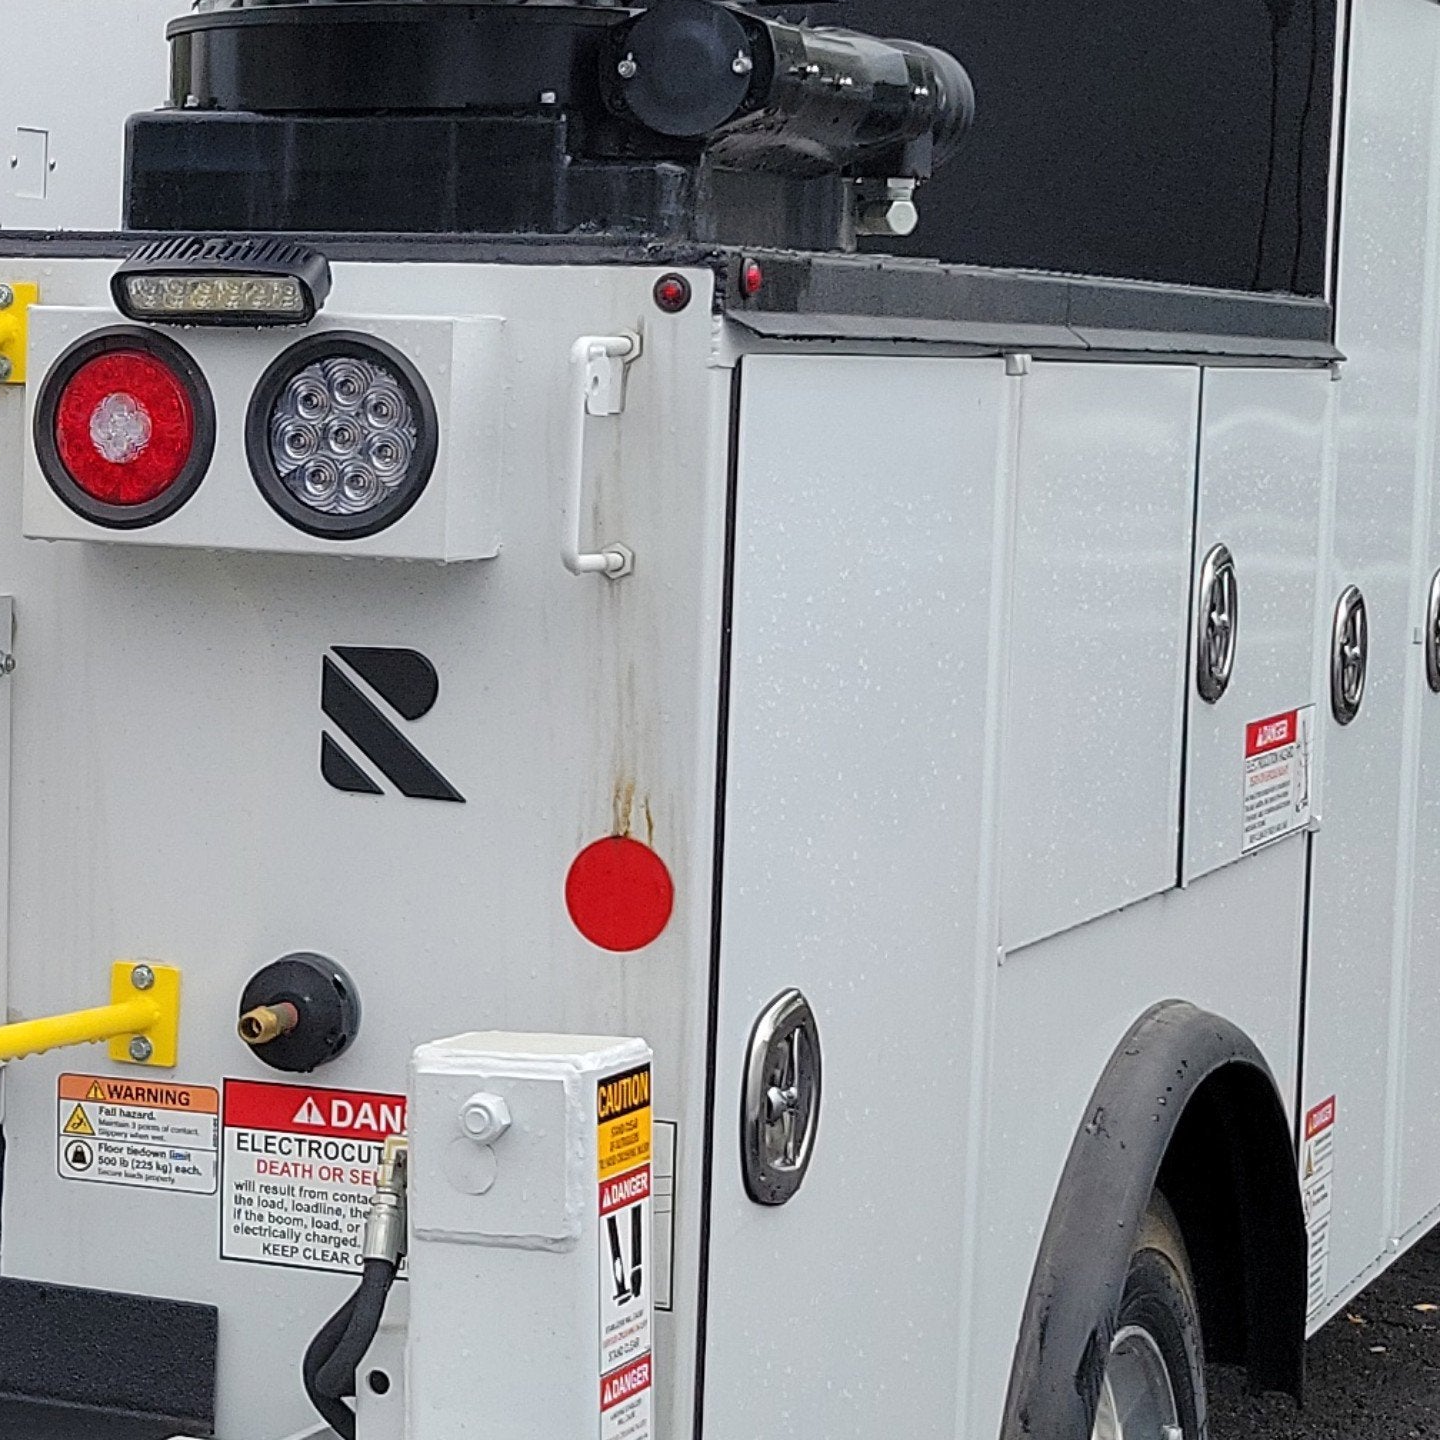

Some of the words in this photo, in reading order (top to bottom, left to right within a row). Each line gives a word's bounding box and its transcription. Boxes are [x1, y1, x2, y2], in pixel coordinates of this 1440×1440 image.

[107, 1084, 190, 1106] WARNING
[598, 1071, 649, 1117] CAUTION
[98, 1106, 116, 1116] Fall
[119, 1109, 156, 1120] hazard.
[331, 1099, 407, 1133] DAN
[98, 1143, 124, 1154] Floor
[127, 1145, 167, 1158] tiedown
[98, 1157, 117, 1167] 500
[120, 1158, 129, 1168] lb
[131, 1160, 154, 1171] (225
[155, 1162, 172, 1174] kg)
[175, 1165, 202, 1176] each.
[256, 1159, 313, 1179] DEATH
[318, 1165, 344, 1183] OR
[234, 1180, 255, 1193] will
[259, 1182, 295, 1197] result
[299, 1186, 328, 1201] from
[612, 1172, 648, 1203] DANGER
[234, 1194, 253, 1207] the
[257, 1196, 288, 1212] load,
[291, 1200, 346, 1219] loadline,
[233, 1209, 243, 1220] if
[245, 1210, 264, 1222] the
[268, 1211, 308, 1229] boom,
[311, 1217, 342, 1233] load,
[346, 1223, 360, 1233] or
[233, 1223, 301, 1243] electrically
[305, 1230, 361, 1249] charged.
[262, 1243, 299, 1258] KEEP
[303, 1247, 350, 1265] CLEAR
[612, 1363, 649, 1398] DANGER
